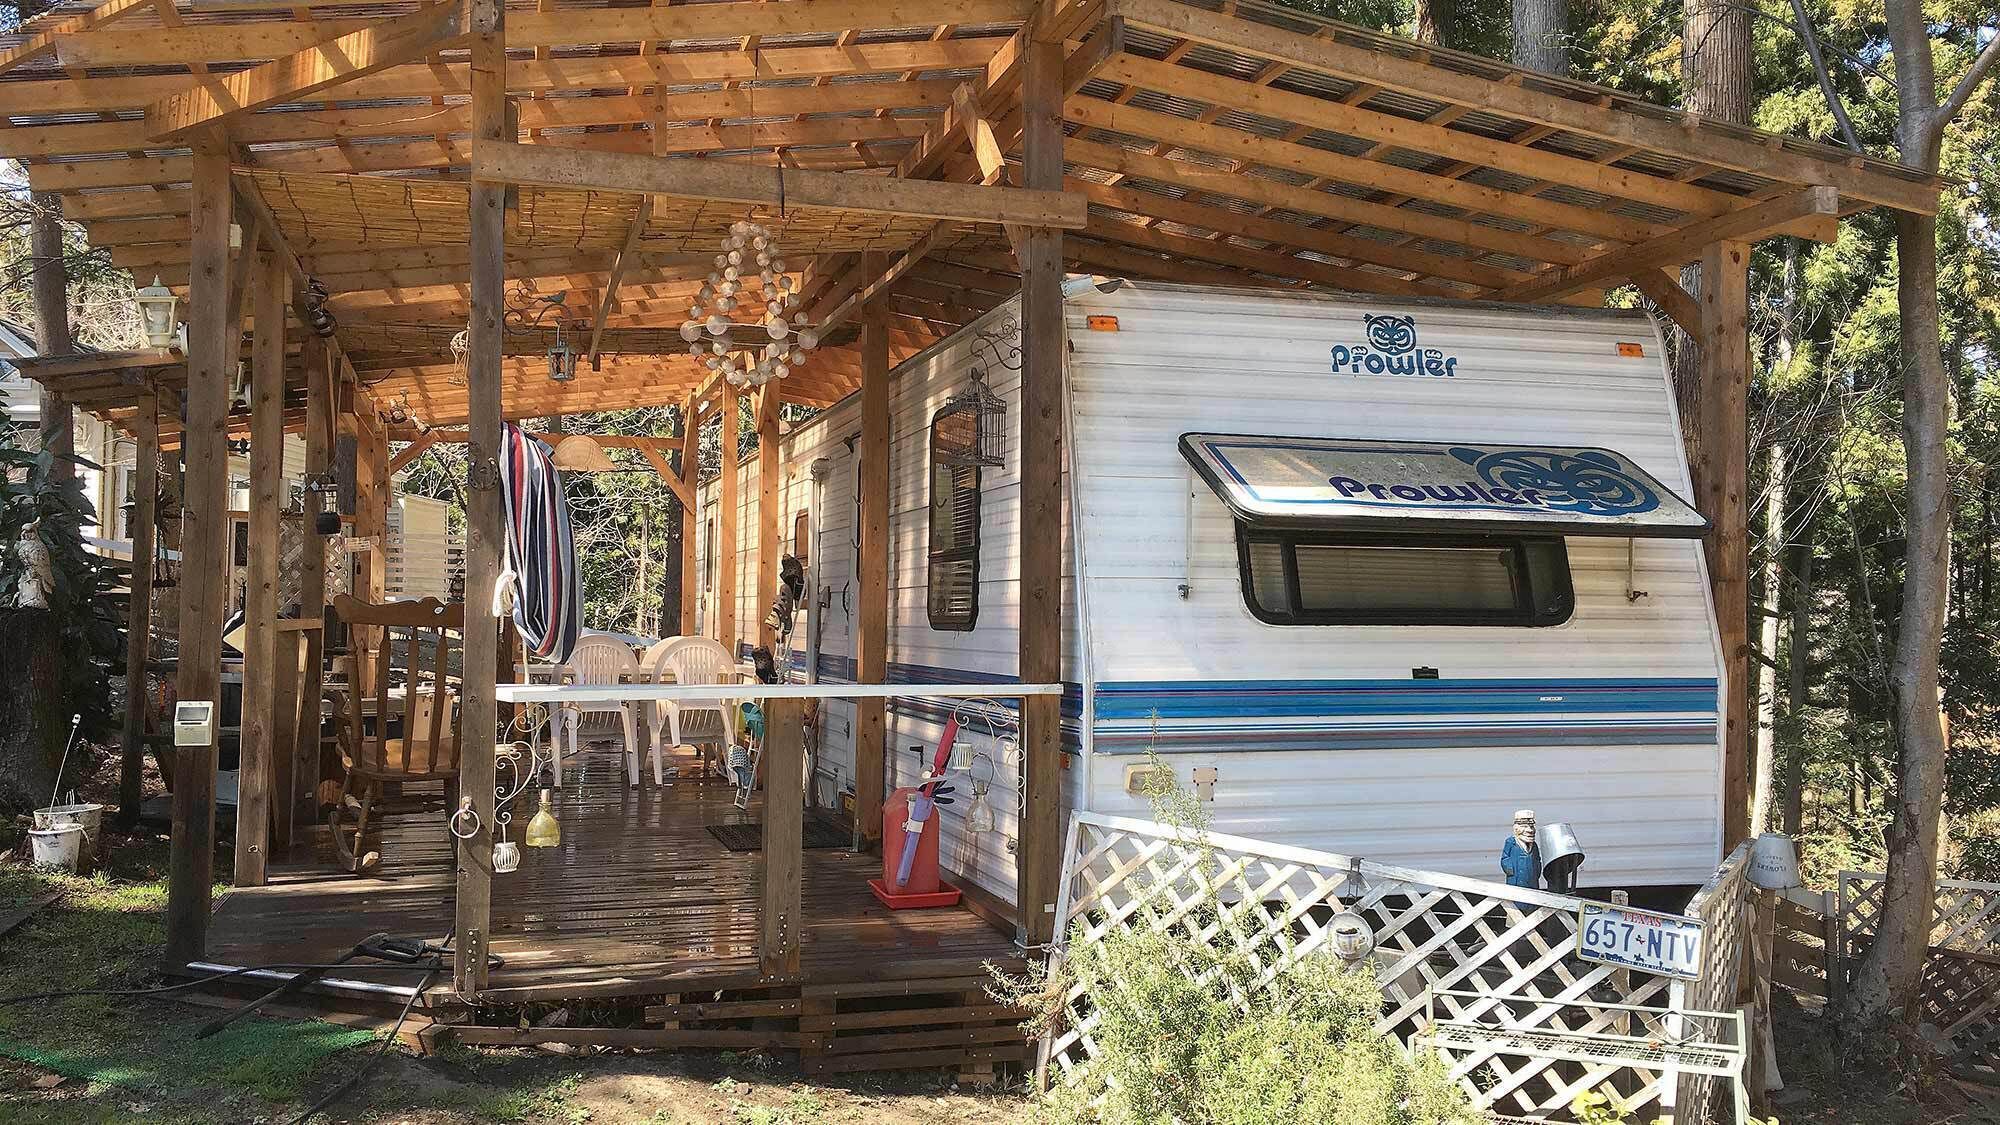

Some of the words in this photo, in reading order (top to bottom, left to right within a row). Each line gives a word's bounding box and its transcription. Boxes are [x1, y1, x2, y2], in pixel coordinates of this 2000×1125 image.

[1331, 345, 1457, 376] Prowler
[1328, 476, 1551, 507] Prowler
[1622, 911, 1662, 927] TEXAS
[1585, 919, 1634, 952] 657
[1647, 928, 1697, 964] NTV
